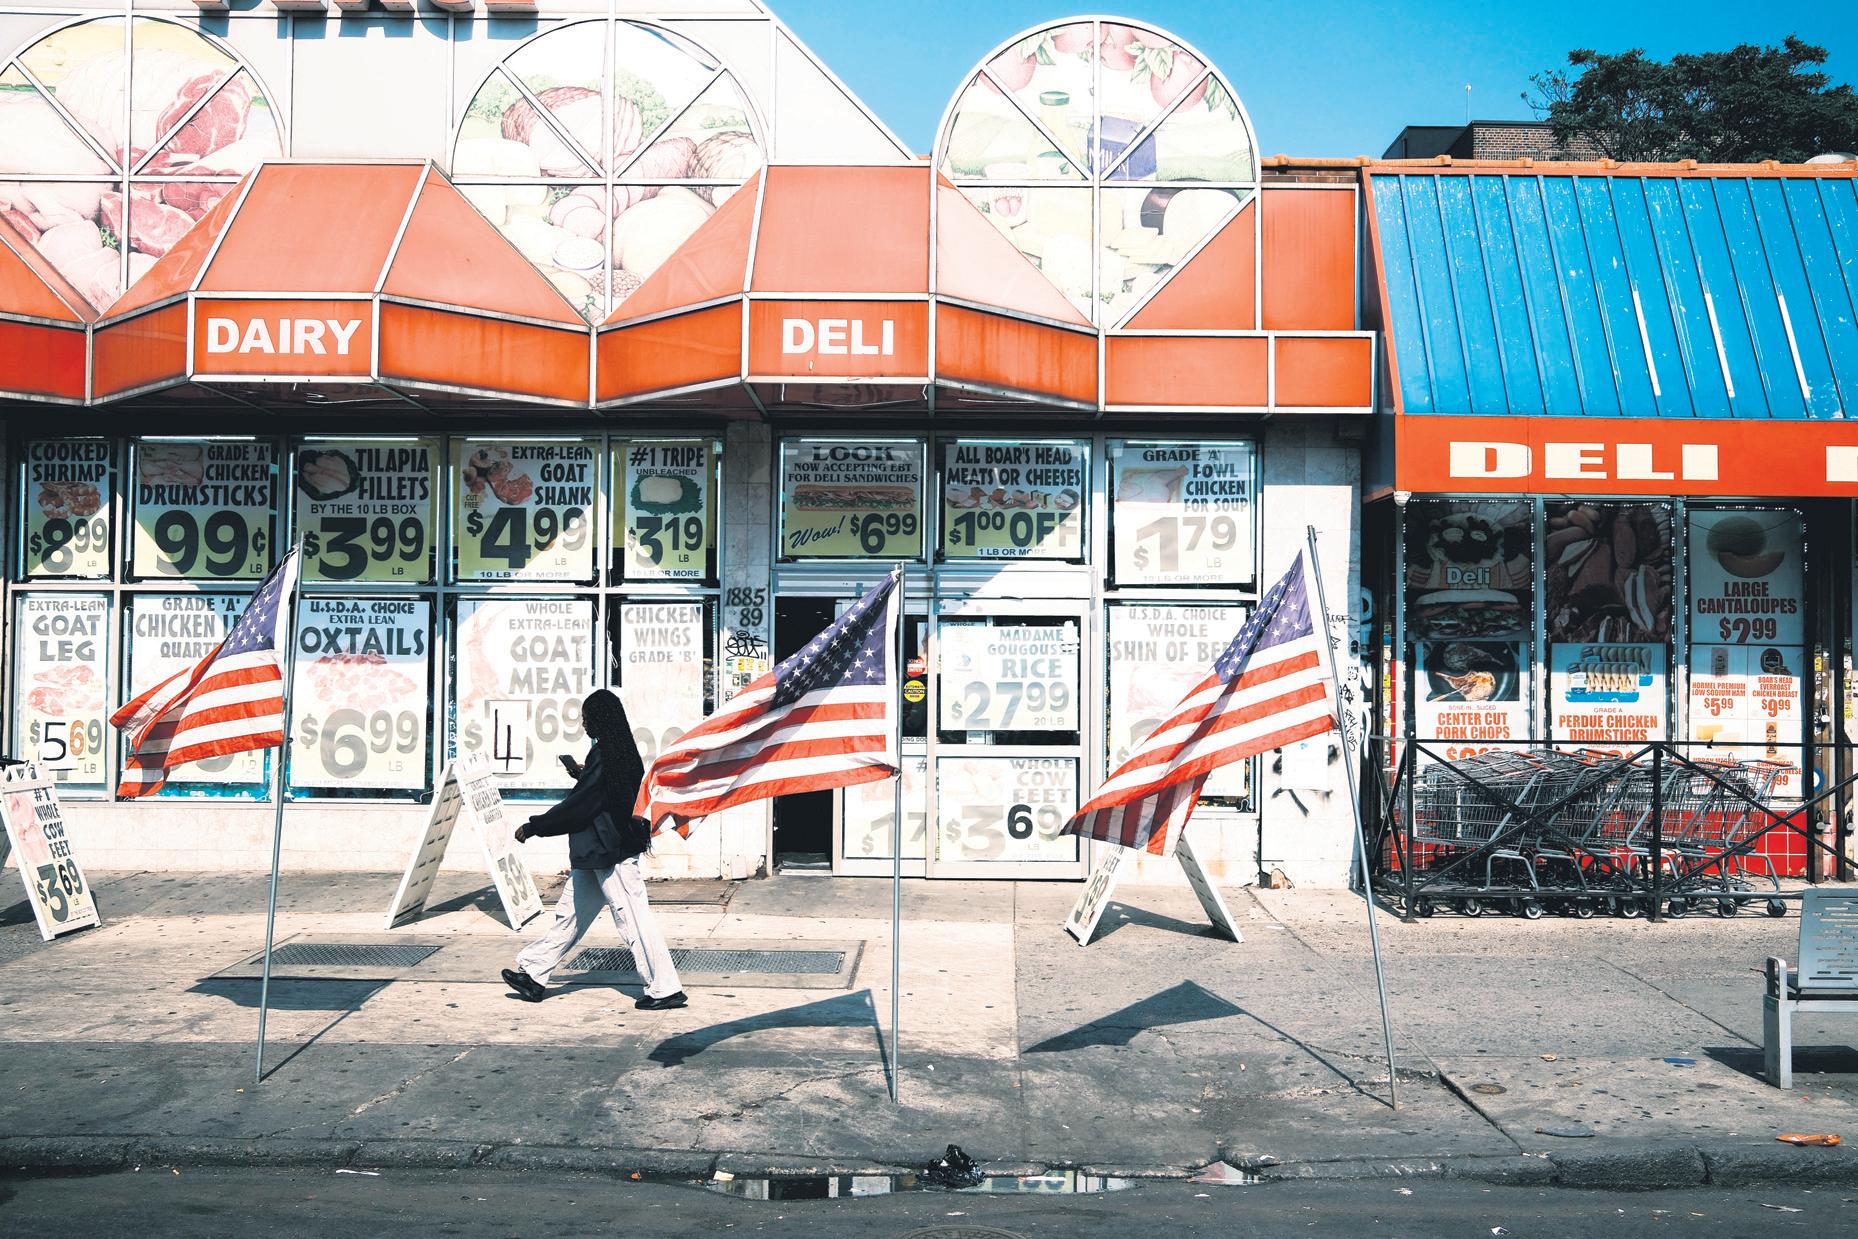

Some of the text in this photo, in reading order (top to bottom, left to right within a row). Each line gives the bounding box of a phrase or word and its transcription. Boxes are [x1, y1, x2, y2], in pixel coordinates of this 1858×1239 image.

[207, 317, 362, 355] DAIRY
[782, 318, 894, 355] DELI
[31, 444, 108, 461] COOKED
[208, 446, 269, 461] GRADE 'A'
[355, 448, 429, 472] TILAPIA
[512, 446, 593, 460] EXTRA-LEAN
[629, 446, 704, 467] #1 TRIPE
[812, 446, 895, 462] LOOK
[956, 447, 1072, 465] ALL BOAR'S HEAD
[1143, 450, 1201, 462] GRADE
[794, 463, 913, 472] NOW ACCEPTING EBT
[1449, 441, 1719, 480] DELI
[32, 464, 106, 482] SHRIMP
[205, 464, 269, 481] CHICKEN
[540, 463, 587, 482] GOAT
[636, 468, 697, 476] UNBLEACHED
[788, 473, 918, 483] FOR DELI SANDWICHES
[947, 467, 1080, 486] MEATS OR CHEESES
[140, 484, 268, 506] DRUMSTICKS
[358, 477, 429, 500] FILLETS
[1185, 481, 1245, 495] CHICKEN
[534, 486, 592, 506] SHANK
[311, 504, 417, 514] BY THE 10 LB BOX
[1184, 498, 1249, 512] FOR SOUP
[789, 515, 846, 549] Wow!
[1010, 511, 1077, 547] OFF
[154, 510, 266, 576] 99¢
[87, 560, 97, 568] LB
[555, 558, 567, 566] LB
[678, 554, 689, 563] LB
[1206, 558, 1223, 568] LB
[250, 563, 262, 574] LB
[392, 567, 404, 575] LB
[1446, 567, 1490, 585] Deli
[725, 587, 766, 607] 1885
[1724, 581, 1769, 598] LARGE
[29, 601, 106, 611] EXTRA-LEAN
[162, 597, 240, 611] GRADE 'A'
[310, 601, 415, 615] U.S.D.A. CHOICE
[526, 603, 572, 614] WHOLE
[1697, 598, 1797, 614] CANTALOUPES
[329, 615, 396, 625] EXTRA LEAN
[624, 607, 701, 624] CHICKEN
[740, 608, 763, 627] 89
[1129, 608, 1227, 620] U.S.D.A. CHOICE
[33, 614, 101, 636] GOAT
[135, 614, 216, 638] CHICKEN
[509, 618, 590, 631] EXTRA-LEAN
[1147, 624, 1208, 637] WHOLE
[300, 627, 425, 655] OXTAILS
[634, 627, 692, 647] WINGS
[1000, 629, 1063, 641] MADAME
[39, 640, 96, 662] LEG
[509, 635, 587, 663] GOAT
[1113, 641, 1188, 662] SHIN OF
[629, 651, 673, 663] GRADE
[1001, 659, 1062, 678] RICE
[508, 668, 587, 694] MEAT
[1034, 717, 1064, 725] 20 LB
[1438, 712, 1507, 726] CENTER CUT
[1559, 715, 1657, 728] PERDUE CHICKEN
[1436, 726, 1509, 739] PORK CHOPS
[1570, 729, 1647, 741] DRUMSTICKS
[84, 763, 97, 774] LB
[388, 760, 404, 772] LB
[1009, 760, 1073, 769] WHOLE
[1016, 771, 1066, 785] COW
[34, 788, 51, 801] #1
[1013, 789, 1071, 803] FEET
[35, 803, 60, 821] WHOLE
[43, 822, 64, 840] COW
[49, 840, 71, 859] FEET
